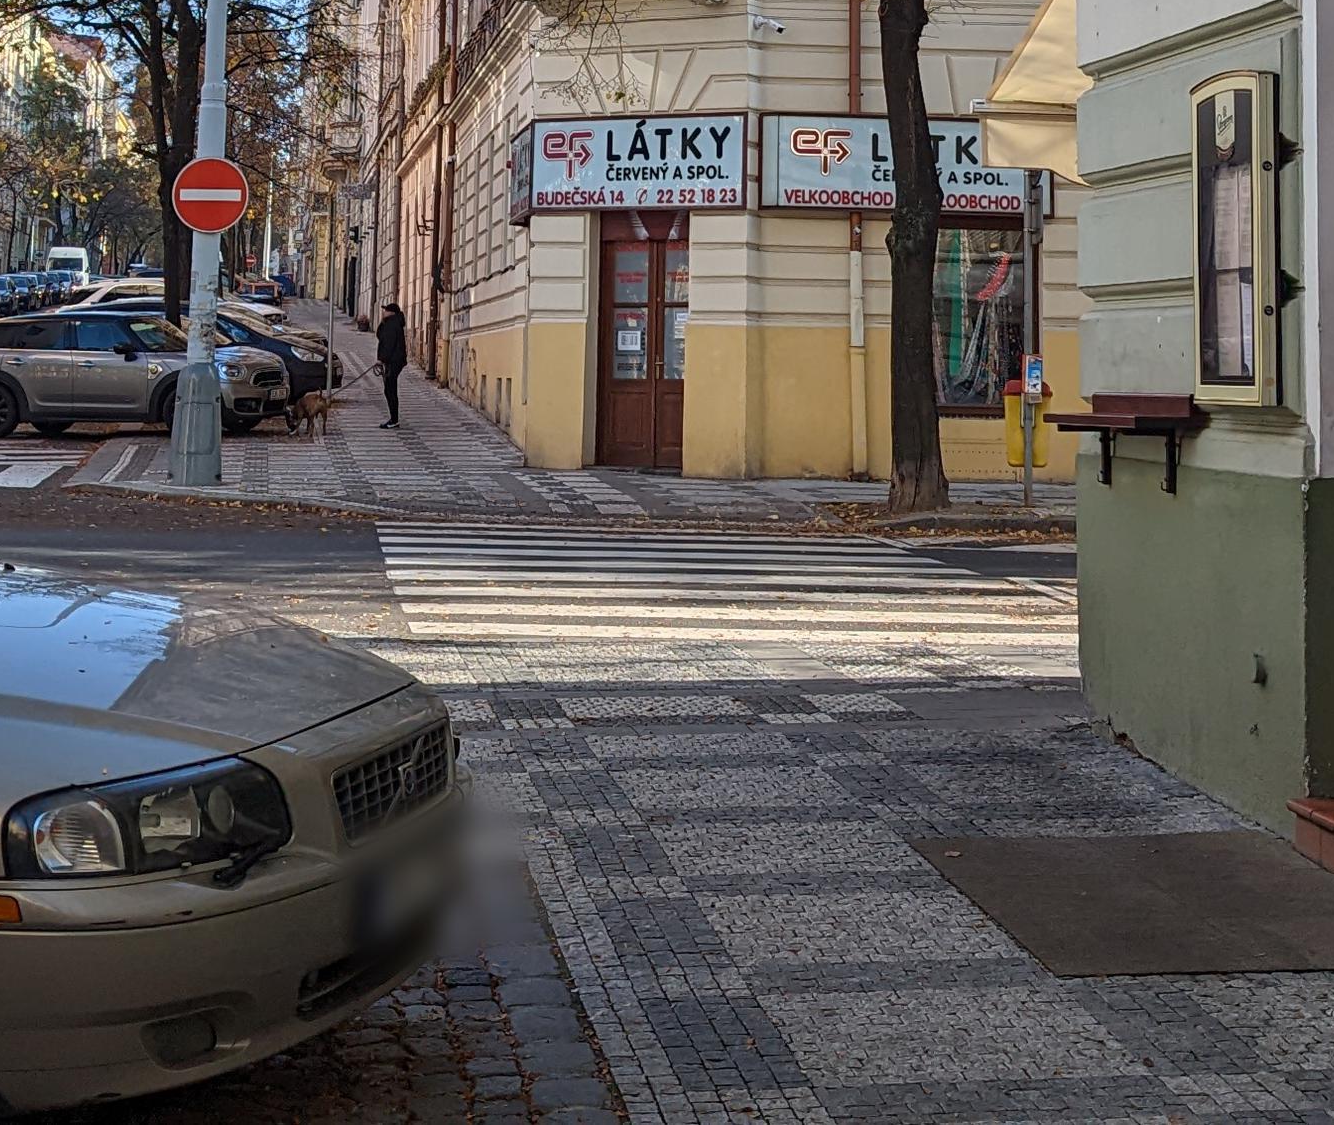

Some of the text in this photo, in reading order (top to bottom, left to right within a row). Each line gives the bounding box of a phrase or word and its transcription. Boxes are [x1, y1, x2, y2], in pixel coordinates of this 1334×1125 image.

[606, 119, 731, 162] LÁTKY
[872, 132, 978, 165] LTK
[606, 163, 729, 181] ČERVENÝ A SPOL.
[947, 171, 958, 184] A
[963, 172, 1009, 186] SPOL.
[536, 186, 737, 206] BUDEČSKÁ 14 22 52 18 23
[784, 188, 893, 206] VELKOOBCHOD
